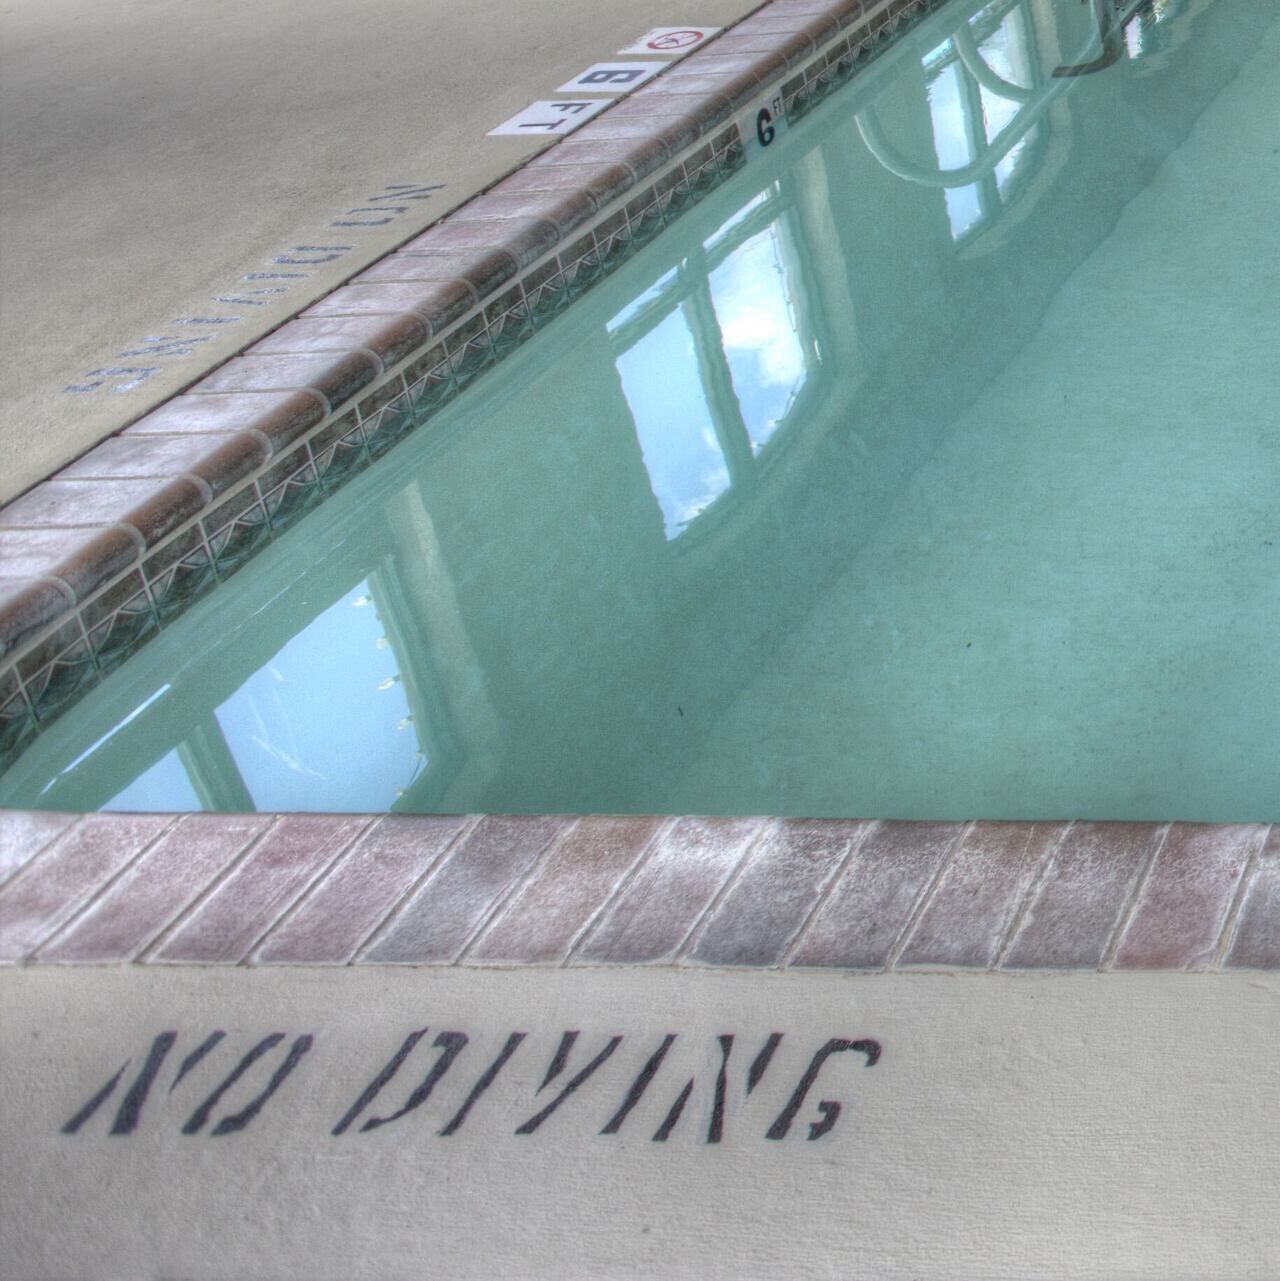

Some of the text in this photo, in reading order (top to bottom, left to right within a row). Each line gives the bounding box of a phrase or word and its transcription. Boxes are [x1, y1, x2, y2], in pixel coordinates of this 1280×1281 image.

[518, 102, 593, 131] FT
[757, 96, 784, 148] 6 FT
[60, 1026, 883, 1145] NO DIVING
